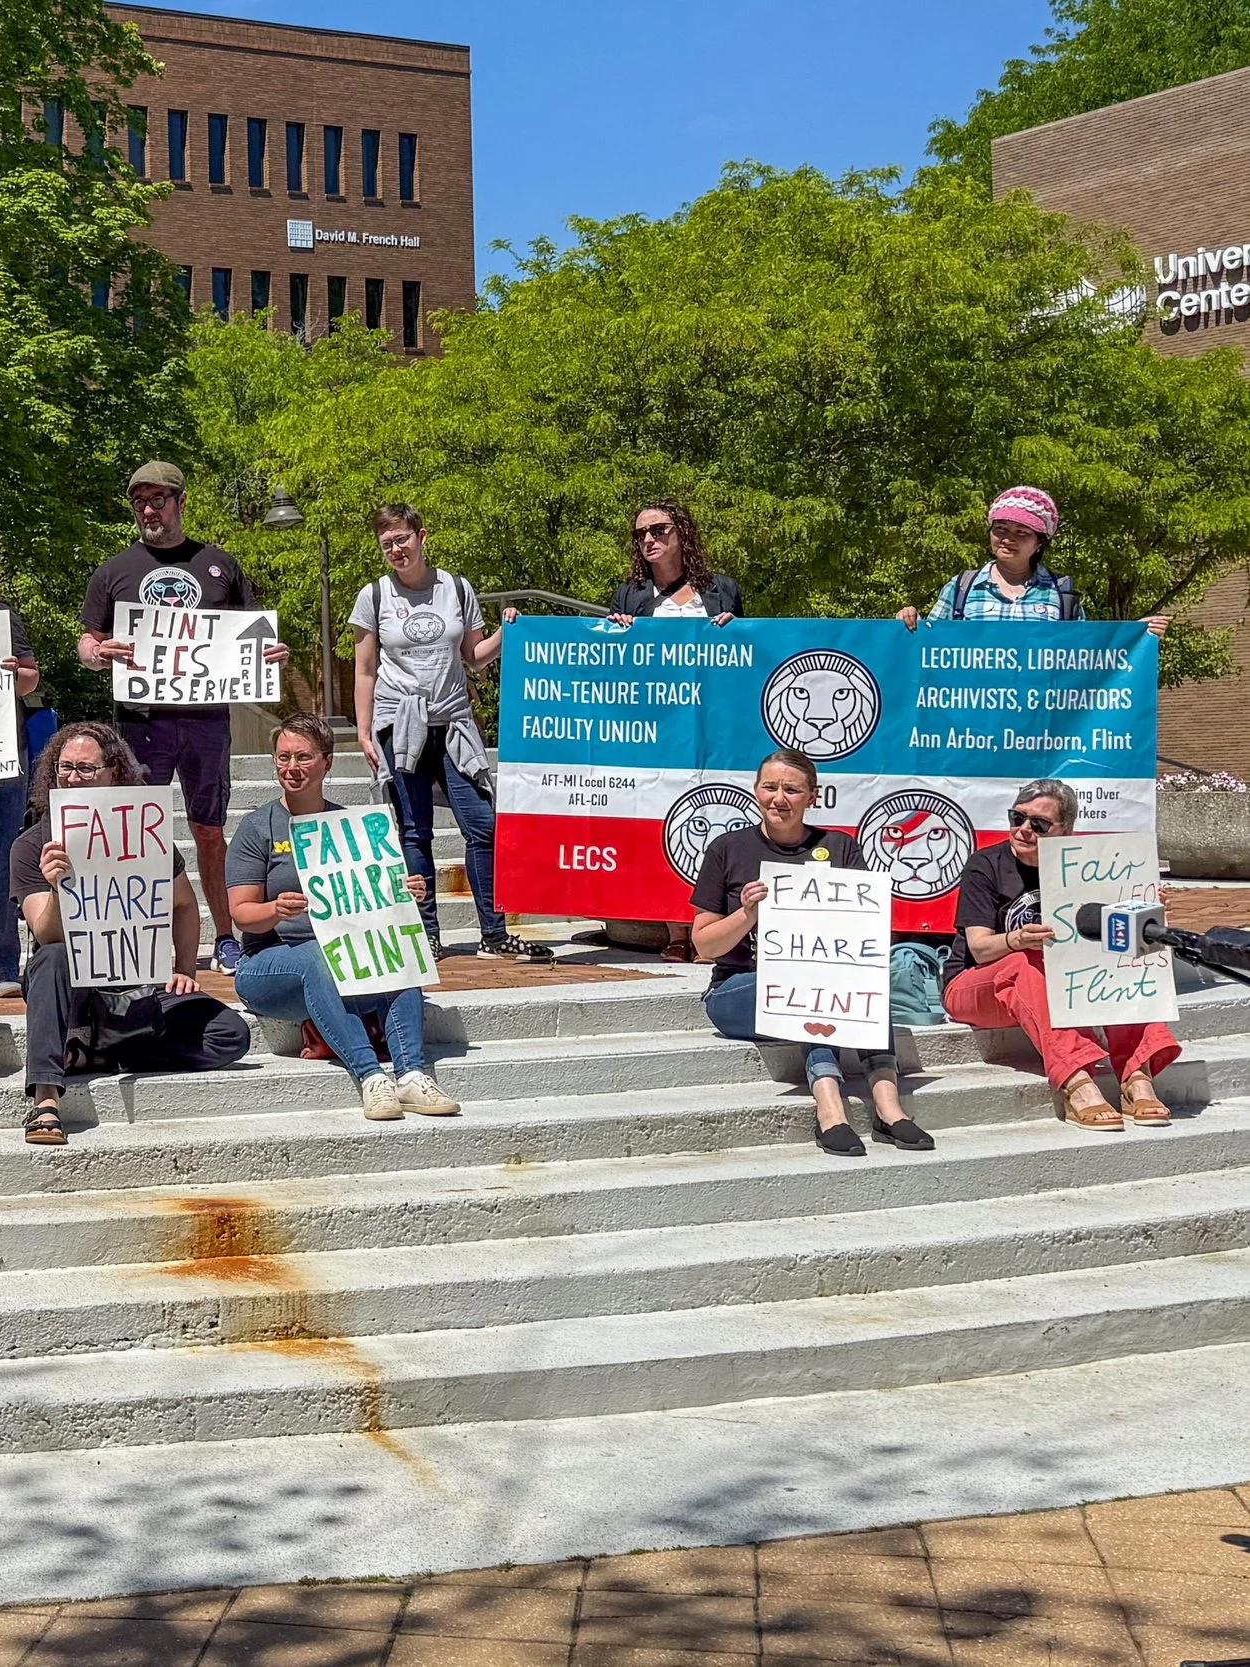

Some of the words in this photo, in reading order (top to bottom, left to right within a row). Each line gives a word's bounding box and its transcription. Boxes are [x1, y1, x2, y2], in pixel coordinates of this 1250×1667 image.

[315, 229, 345, 242] David
[347, 232, 360, 243] M.
[362, 233, 398, 246] French
[400, 235, 420, 248] Hall
[128, 608, 221, 640] FLINT
[126, 642, 211, 678] LECS
[240, 643, 252, 695] MORE
[525, 641, 628, 667] UNIVERSITY
[632, 643, 655, 666] OF
[661, 643, 753, 667] MICHIGAN
[921, 647, 1022, 672] LECTURERS,
[1027, 648, 1133, 673] LIBRARIANS,
[128, 676, 241, 702] DESERVE
[524, 678, 639, 705] NON-TENURE
[646, 681, 702, 706] TRACK
[916, 686, 1022, 713] ARCHIVISTS,
[1027, 690, 1039, 710] &
[1044, 687, 1132, 710] CURATORS
[522, 715, 593, 741] FACULTY
[599, 719, 657, 744] UNION
[909, 726, 941, 748] Ann
[946, 727, 998, 752] Arbor,
[1003, 728, 1087, 753] Dearborn,
[1091, 728, 1133, 750] Flint
[541, 774, 577, 788] AFT-MI
[579, 775, 606, 788] Local
[608, 776, 636, 789] 6244
[1096, 786, 1120, 800] Over
[568, 793, 608, 807] AFL-CIO
[813, 785, 837, 809] EO
[1078, 806, 1107, 819] rkers
[60, 802, 168, 862] FAIR
[290, 812, 401, 870] FAIR
[558, 844, 617, 872] LECS
[1061, 846, 1145, 887] Fair
[60, 874, 170, 921] SHARE
[307, 862, 414, 921] SHARE
[773, 874, 880, 908] FAIR
[68, 923, 170, 982] FLINT
[322, 923, 428, 983] FLINT
[764, 930, 886, 962] SHARE
[766, 984, 882, 1018] FLINT
[1065, 965, 1157, 1009] Flint
